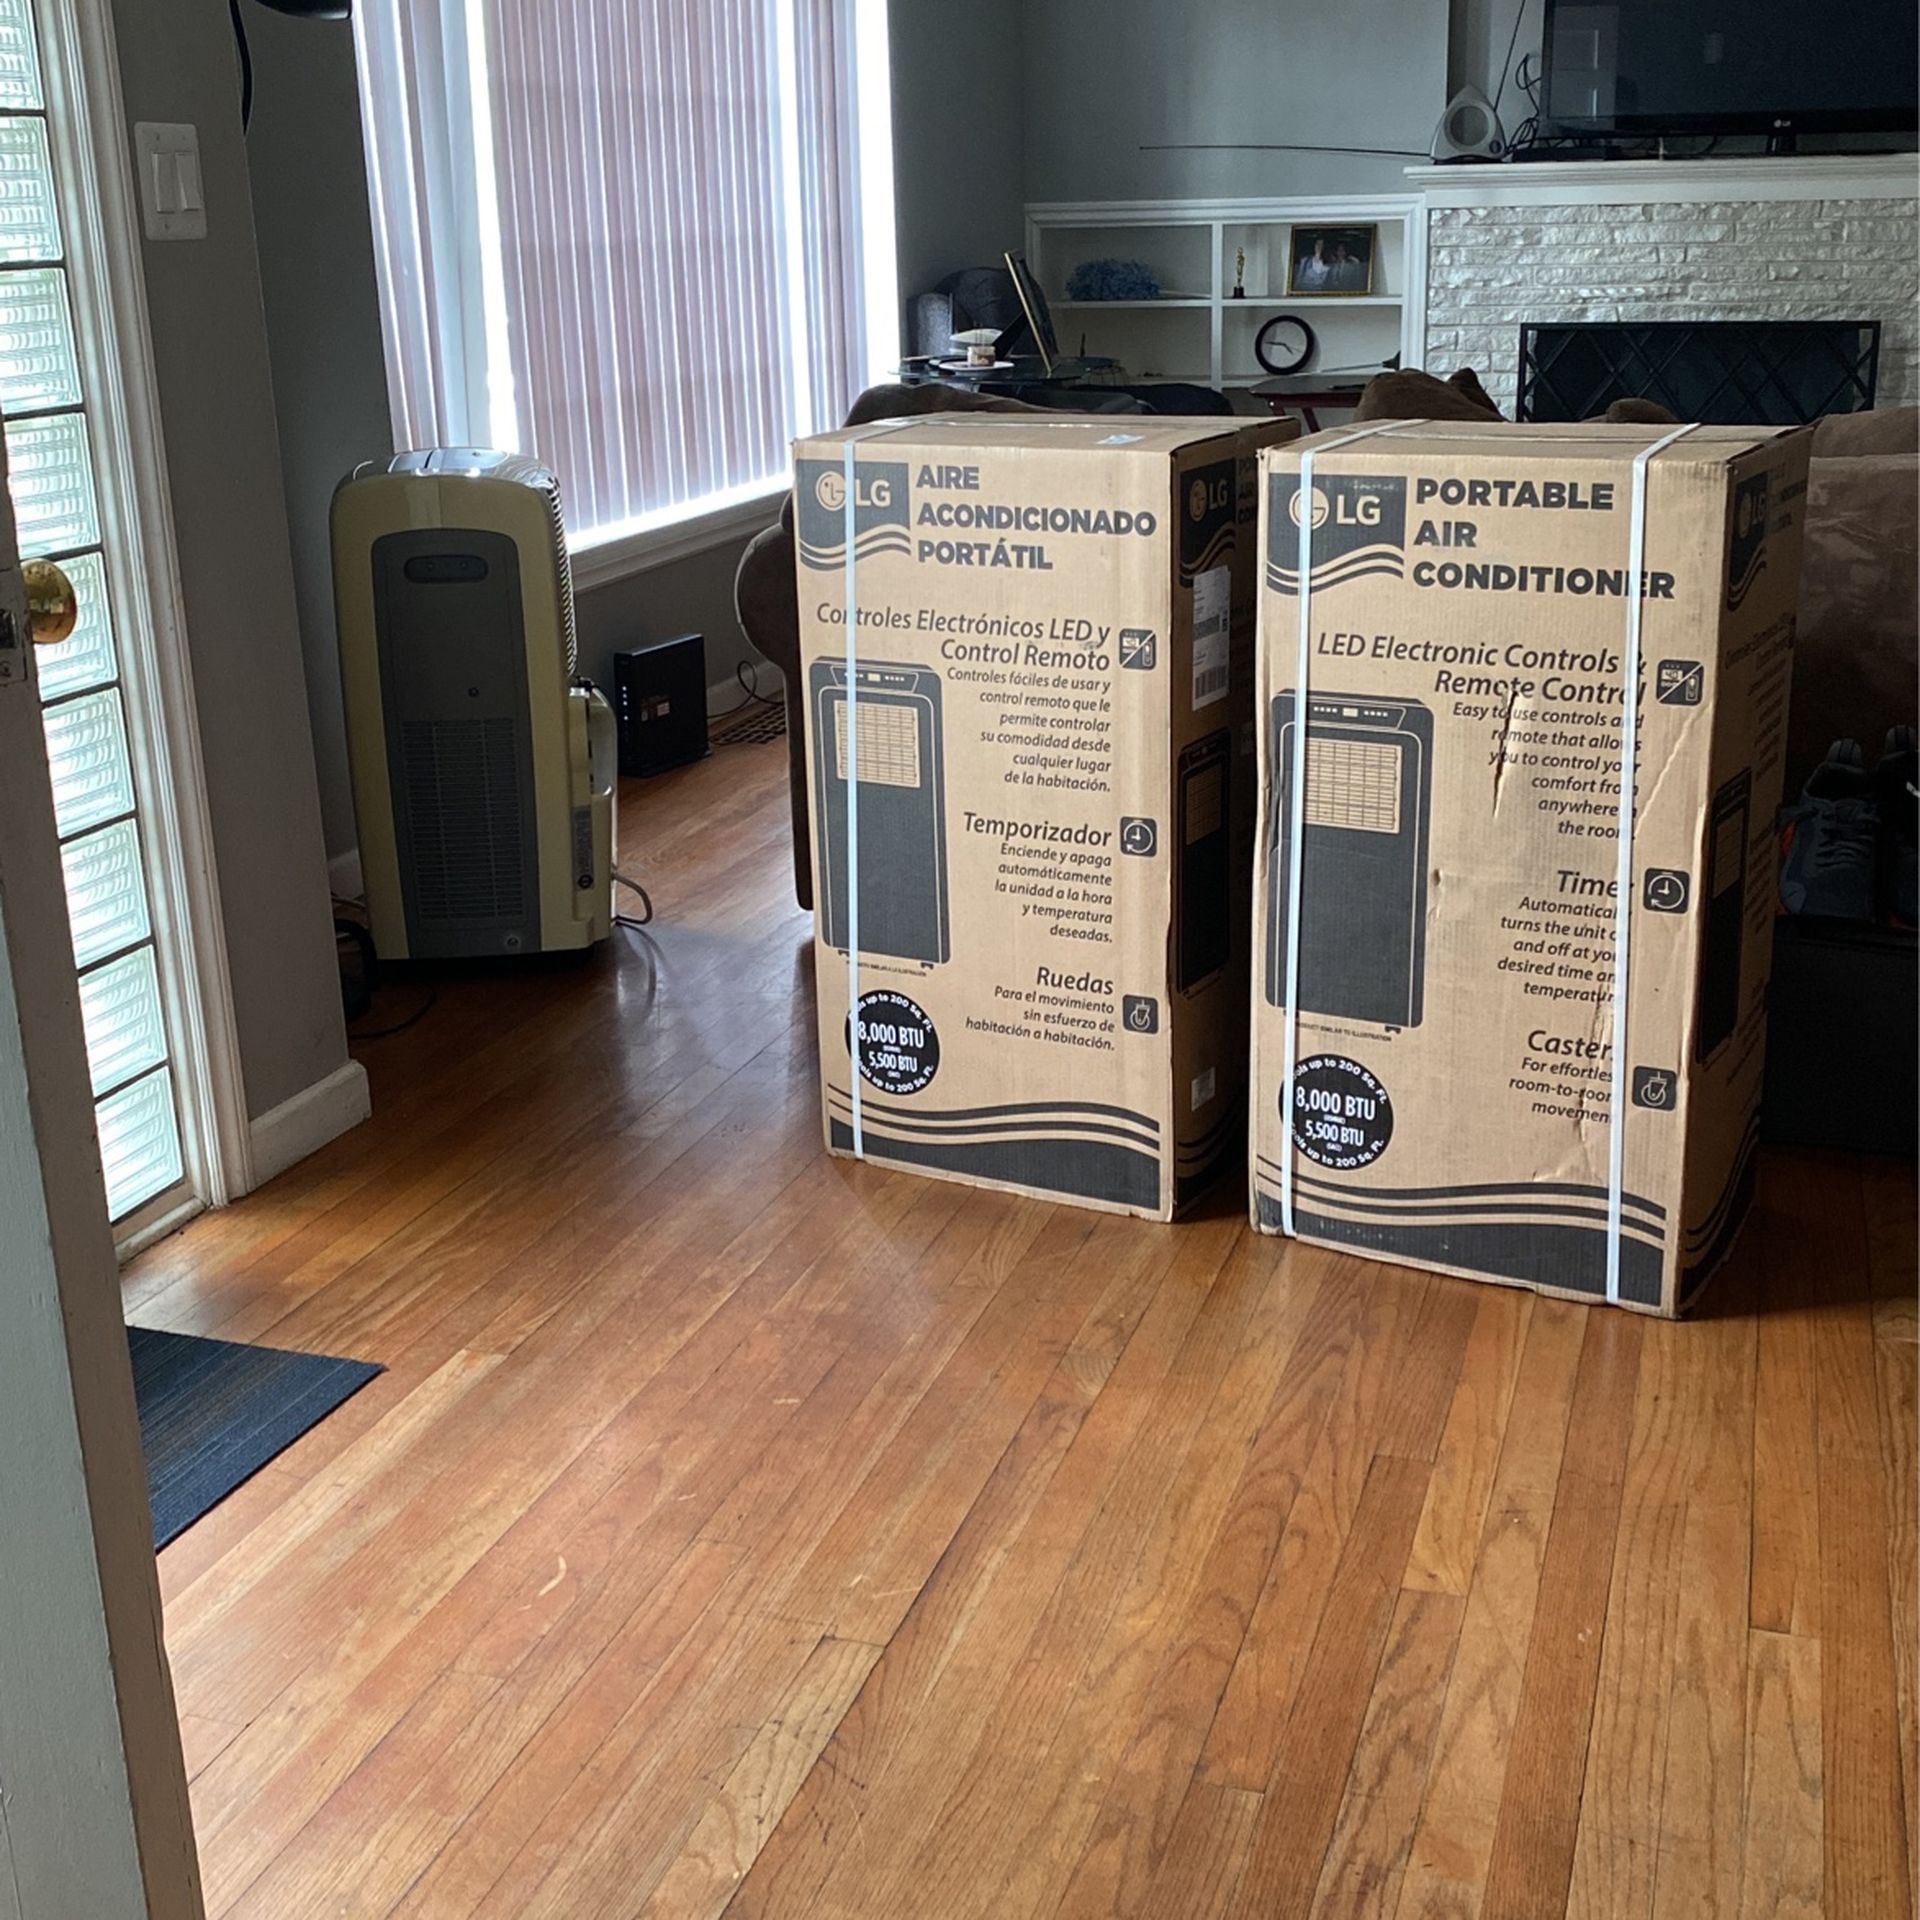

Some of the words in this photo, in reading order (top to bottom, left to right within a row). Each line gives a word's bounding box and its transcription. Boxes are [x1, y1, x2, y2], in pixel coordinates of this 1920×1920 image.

[916, 465, 980, 490] AIRE
[855, 479, 891, 508] LG
[1208, 479, 1229, 511] LG
[1416, 478, 1614, 511] PORTABLE
[917, 502, 1157, 536] ACONDICIONADO
[1336, 494, 1381, 526] LG
[1413, 520, 1477, 548] AIR
[918, 537, 1053, 570] PORTÁTIL
[817, 602, 912, 629] Cotroles
[917, 609, 1044, 638] Electrónicos
[1049, 617, 1093, 641] LED
[1097, 626, 1111, 648] y
[941, 638, 1020, 665] Control
[1024, 645, 1110, 671] Remoto
[1317, 632, 1366, 657] LED
[1371, 635, 1499, 666] Electronic
[1504, 644, 1619, 673] Controls
[947, 667, 1007, 684] Controles
[1009, 671, 1050, 687] fáciles
[1052, 675, 1069, 689] de
[1071, 679, 1101, 691] usar
[1101, 681, 1111, 695] y
[1434, 670, 1535, 699] Remote
[980, 691, 1023, 705] control
[1024, 697, 1070, 710] remoto
[1072, 699, 1097, 713] que
[1098, 699, 1111, 712] le
[1000, 713, 1048, 727] permite
[1050, 717, 1111, 732] controlar
[1453, 702, 1489, 721] Easy
[1492, 705, 1508, 719] to
[1512, 708, 1539, 722] use
[1541, 711, 1607, 727] controls
[1611, 714, 1645, 729] ad
[980, 731, 995, 742] su
[997, 733, 1070, 749] comodidad
[1071, 738, 1111, 753] desde
[1551, 731, 1590, 748] that
[1589, 734, 1642, 751] allos
[1012, 753, 1073, 769] cualquier
[1075, 757, 1111, 774] lugar
[1522, 752, 1538, 766] to
[1541, 755, 1600, 771] control
[1602, 761, 1641, 776] yor
[1004, 770, 1019, 783] de
[1022, 771, 1034, 785] la
[1037, 773, 1111, 792] habitación.
[1531, 776, 1597, 793] comfort
[1538, 799, 1619, 817] anywhere
[963, 811, 1112, 847] Temporizador
[1558, 820, 1585, 836] the
[1000, 842, 1057, 861] Enciende
[1059, 851, 1068, 864] y
[1069, 852, 1112, 868] apaga
[998, 863, 1112, 886] automáticamente
[1557, 870, 1634, 898] Time
[994, 879, 1007, 892] la
[1009, 881, 1055, 898] unidad
[1056, 889, 1064, 899] a
[1066, 888, 1080, 901] la
[1081, 890, 1112, 905] hora
[1022, 904, 1030, 916] y
[1032, 904, 1113, 924] temperatura
[1049, 924, 1113, 943] deseadas.
[1500, 916, 1541, 933] turns
[1544, 920, 1571, 936] the
[1573, 924, 1606, 941] unit
[1513, 940, 1545, 953] and
[1547, 942, 1572, 957] off
[1572, 947, 1589, 959] at
[1036, 966, 1114, 996] Ruedas
[1497, 957, 1555, 975] desired
[1557, 965, 1594, 980] time
[1596, 971, 1616, 984] an
[878, 993, 889, 1002] to
[890, 995, 909, 1008] 200
[994, 985, 1022, 1001] Para
[1025, 990, 1037, 1003] el
[1038, 994, 1115, 1014] movimiento
[1523, 982, 1615, 1002] temperatur
[965, 1017, 1031, 1037] habitación
[1033, 1030, 1042, 1040] a
[1043, 1029, 1115, 1051] habitación.
[1023, 1009, 1041, 1021] sin
[1043, 1014, 1096, 1030] esfuerzo
[1098, 1019, 1115, 1033] de
[858, 1021, 896, 1044] 8,000
[899, 1026, 924, 1048] BTU
[1527, 1029, 1613, 1062] Caster
[869, 1051, 897, 1070] 5,500
[898, 1055, 918, 1073] BTU
[1308, 1059, 1323, 1069] up
[1324, 1058, 1337, 1067] to
[1338, 1060, 1361, 1075] 200
[1361, 1072, 1377, 1090] Sq.
[1521, 1057, 1548, 1072] For
[896, 1083, 914, 1092] 200
[1296, 1086, 1341, 1112] 8,000
[1345, 1094, 1376, 1121] BTU
[1531, 1102, 1612, 1124] movemen
[1305, 1119, 1339, 1140] 5,500
[1340, 1125, 1364, 1147] BTU
[1306, 1147, 1320, 1160] up
[1321, 1155, 1334, 1165] to
[1336, 1157, 1357, 1167] 200
